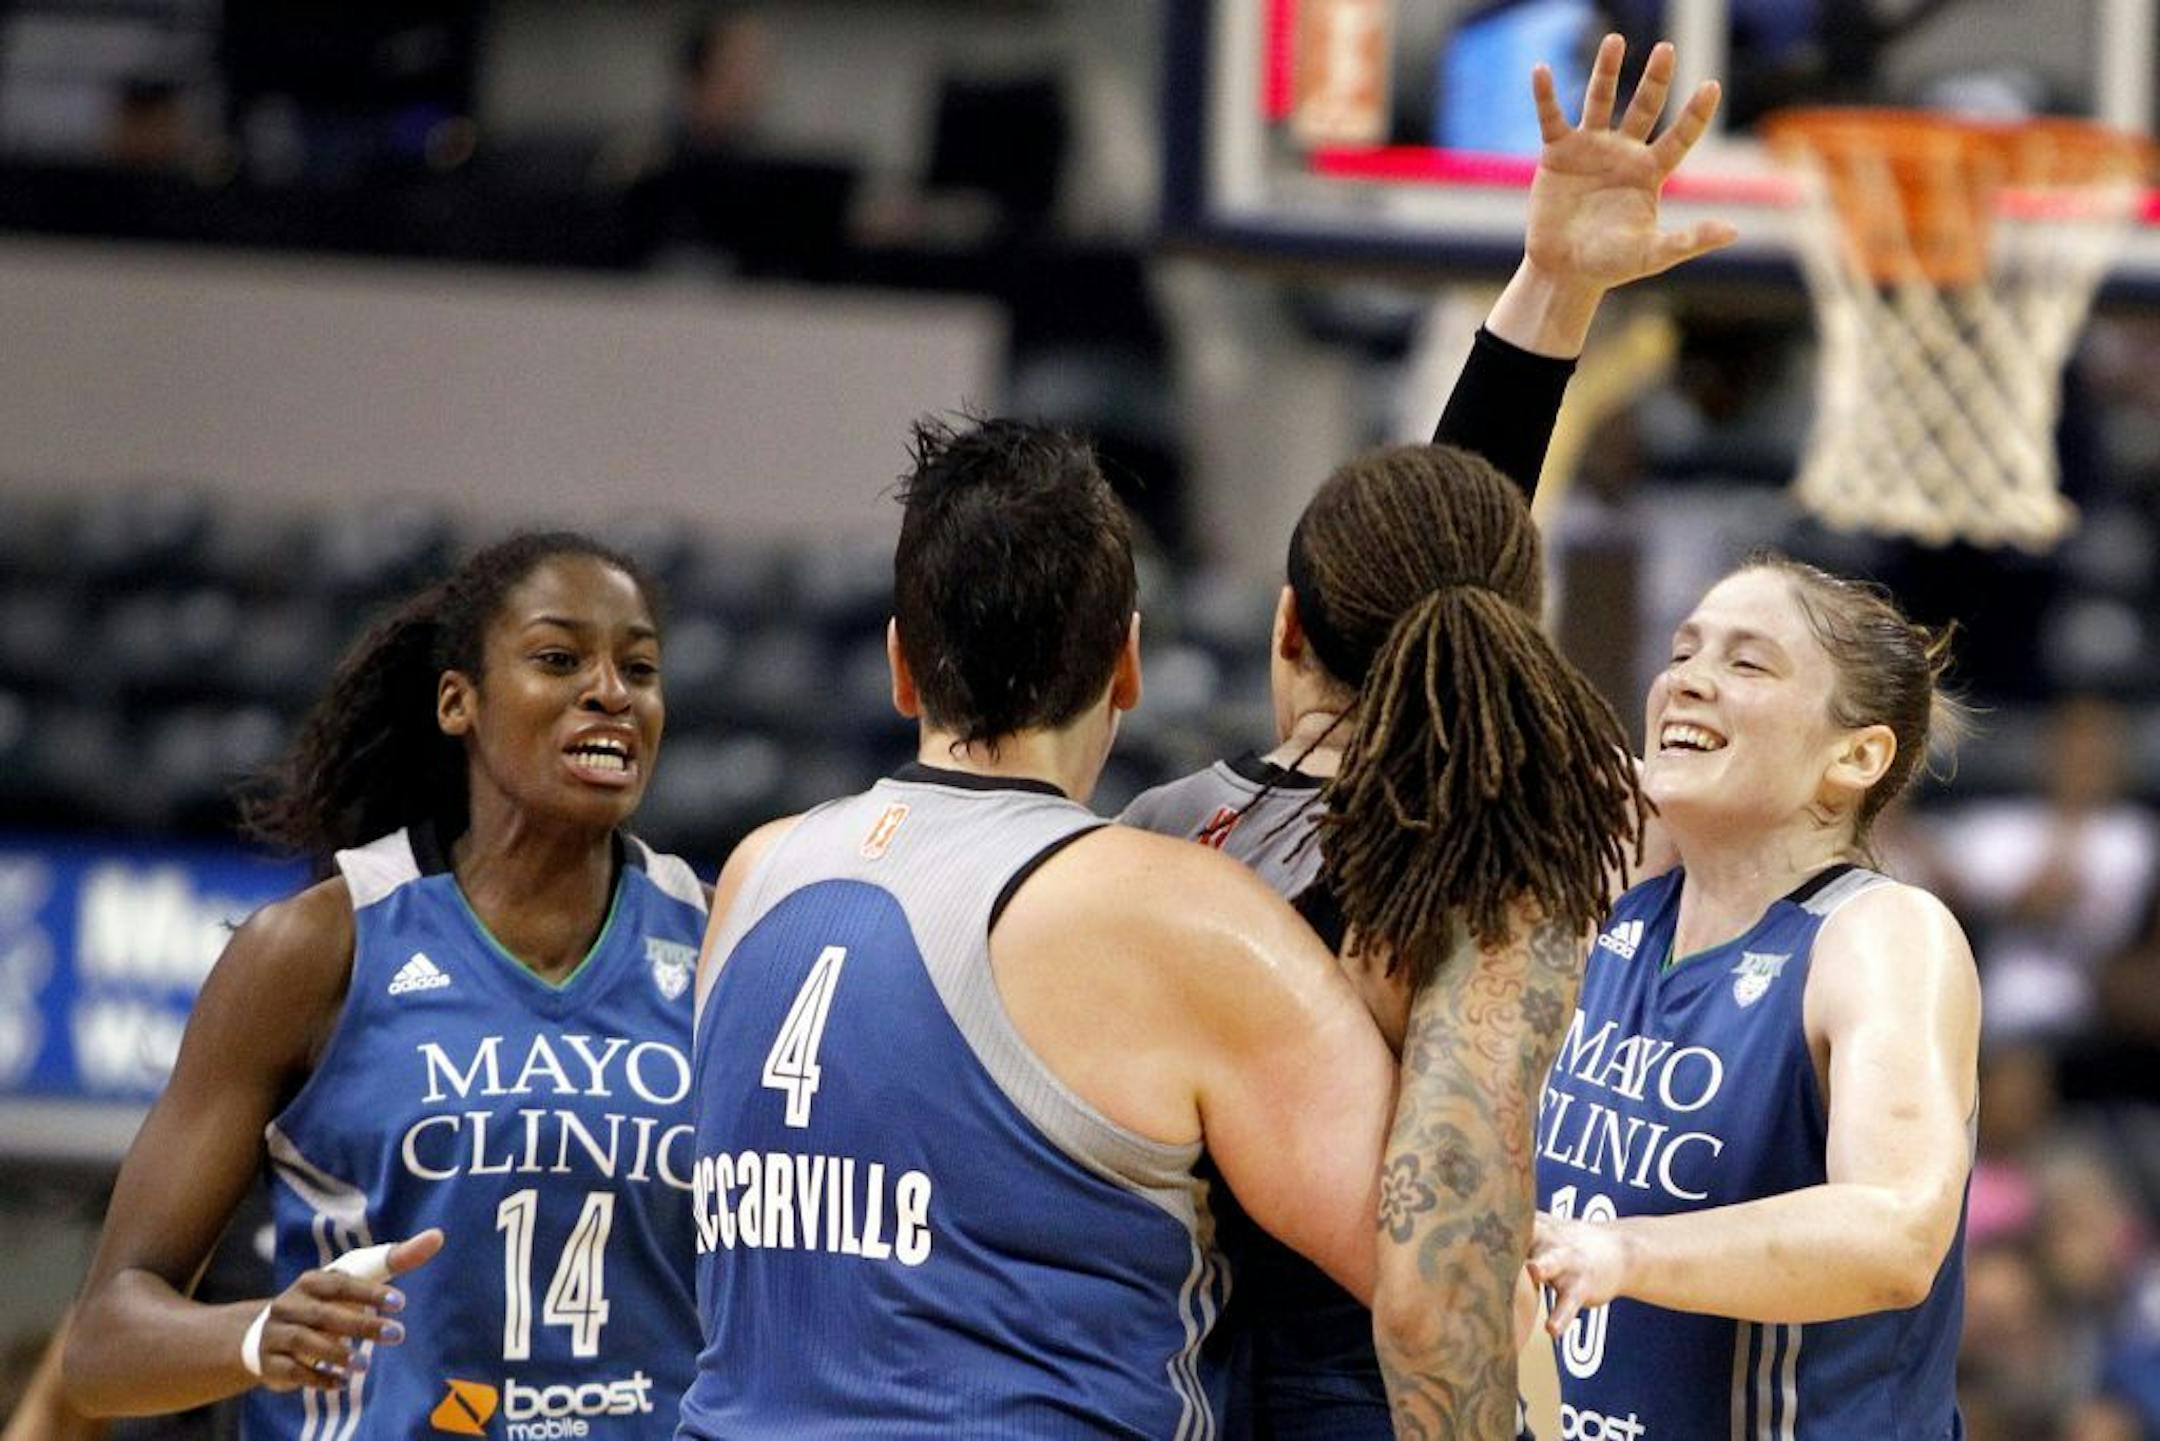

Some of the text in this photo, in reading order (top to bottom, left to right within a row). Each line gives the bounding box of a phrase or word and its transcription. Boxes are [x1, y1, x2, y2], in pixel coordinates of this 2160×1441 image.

[417, 1034, 691, 1104] MAYO
[762, 946, 847, 1128] 4
[1556, 1008, 1723, 1112] MAYO
[402, 1109, 695, 1190] CLINIC
[496, 1188, 615, 1361] 14
[504, 1370, 653, 1421] boost
[506, 1417, 589, 1441] mobile
[1560, 1403, 1646, 1441] oost
